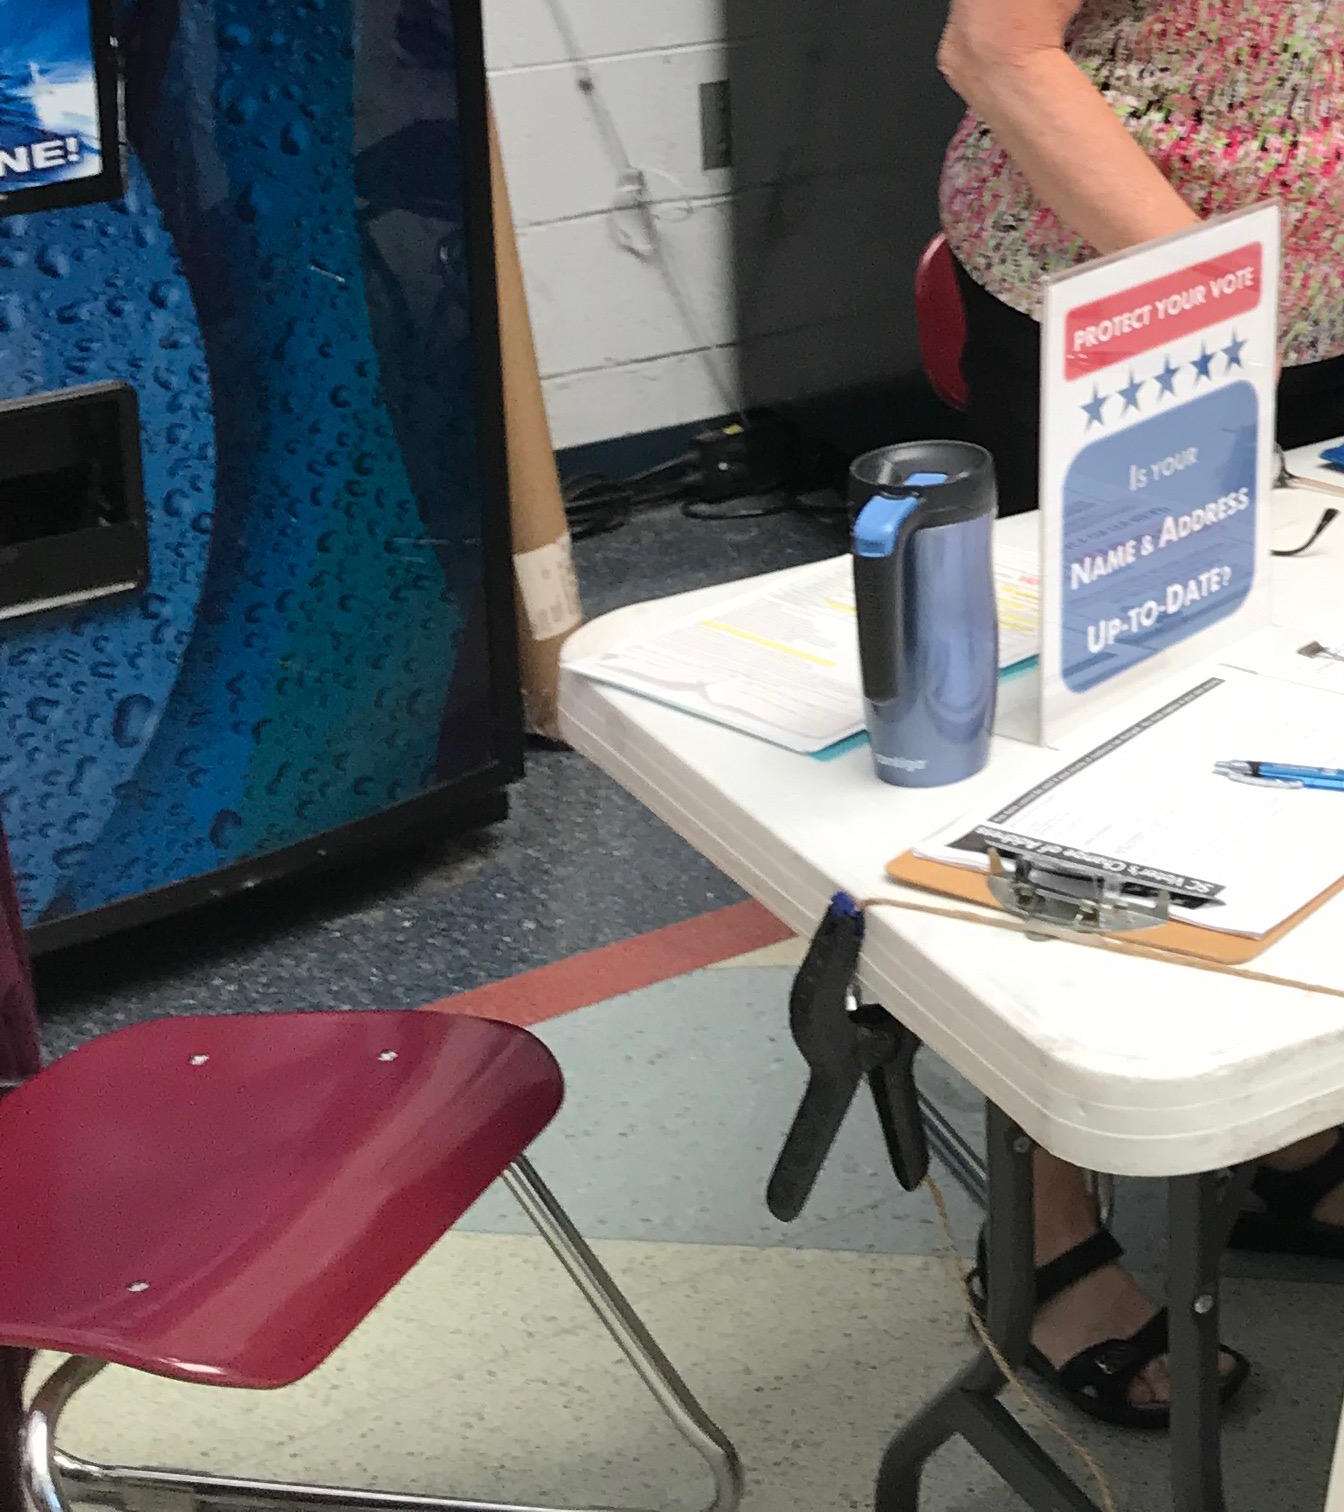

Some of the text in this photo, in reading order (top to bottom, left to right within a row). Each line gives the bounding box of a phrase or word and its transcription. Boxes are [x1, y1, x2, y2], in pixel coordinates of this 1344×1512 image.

[1073, 265, 1255, 352] PROTECT YOUR VOTE
[1139, 534, 1155, 556] &
